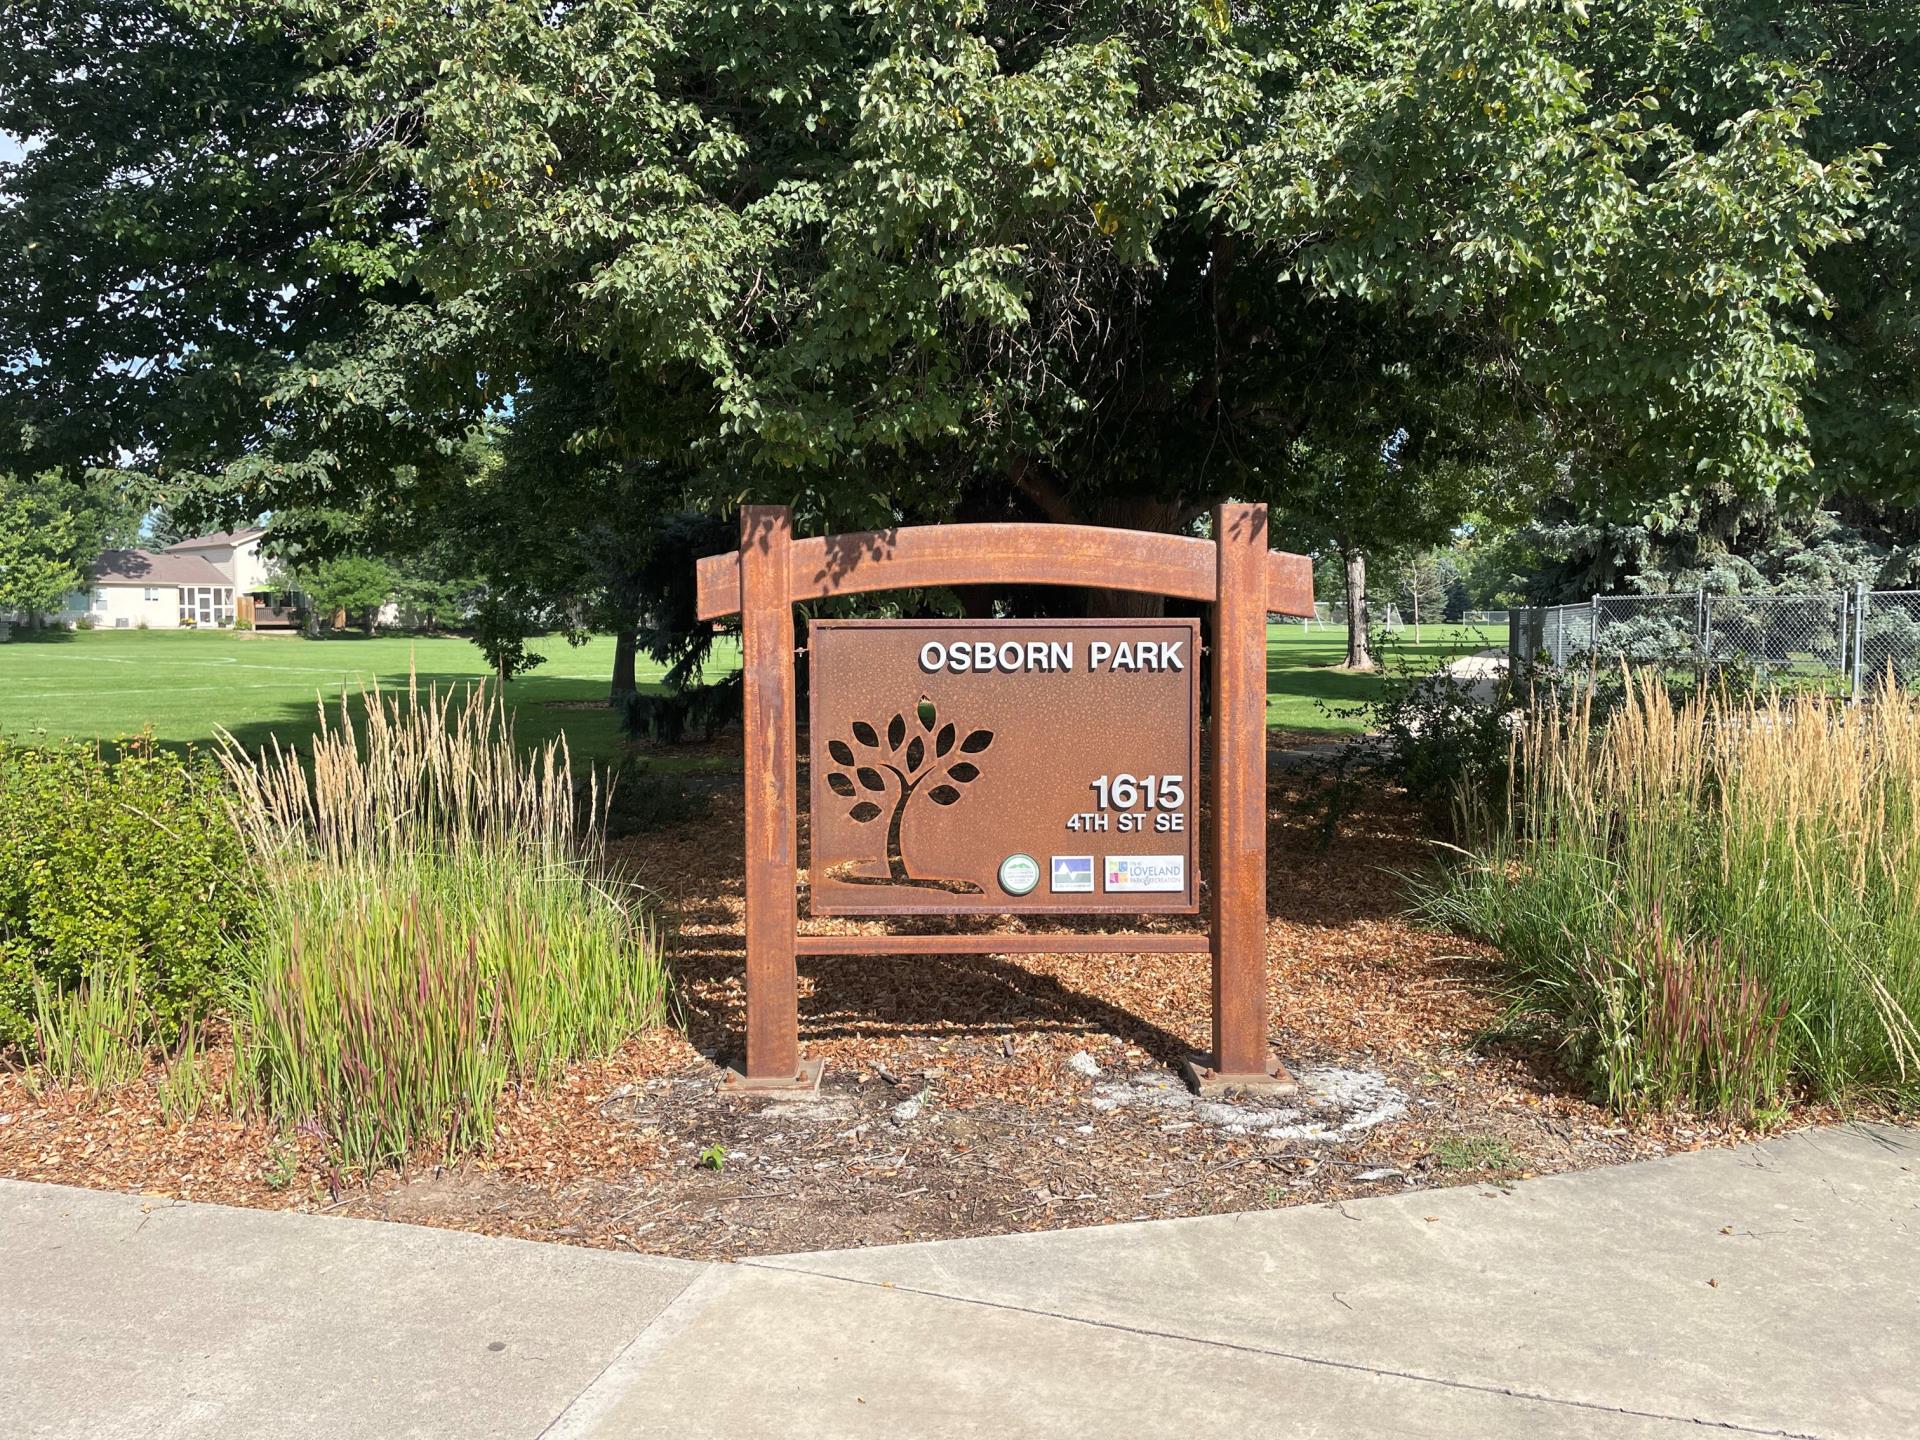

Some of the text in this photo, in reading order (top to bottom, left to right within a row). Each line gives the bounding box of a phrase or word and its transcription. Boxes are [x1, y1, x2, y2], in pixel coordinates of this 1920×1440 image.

[920, 641, 1184, 670] OSBORN PARK
[1091, 773, 1185, 809] 1615
[1067, 813, 1185, 831] 4TH ST SE
[1129, 865, 1181, 877] LOVELAND
